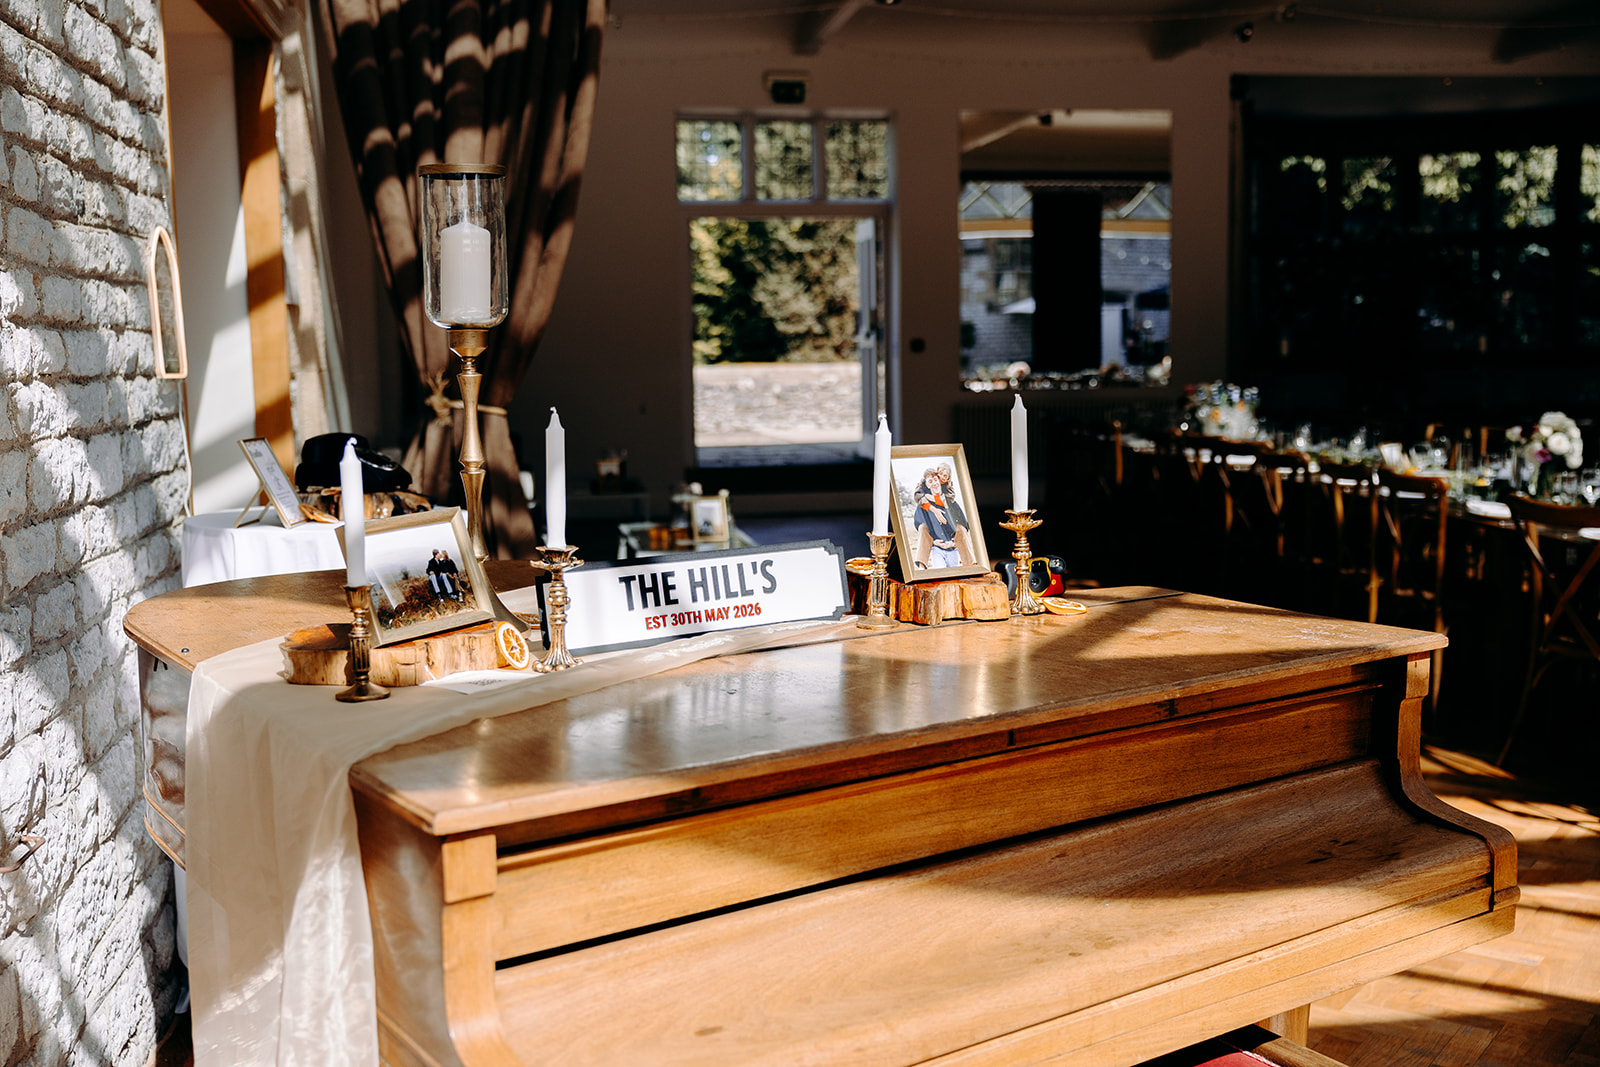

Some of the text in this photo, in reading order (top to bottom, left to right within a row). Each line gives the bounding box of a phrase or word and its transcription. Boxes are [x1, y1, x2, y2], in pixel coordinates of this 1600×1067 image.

[618, 560, 777, 611] THE HILL'S
[645, 602, 761, 630] EST 30TH MAY 2026
